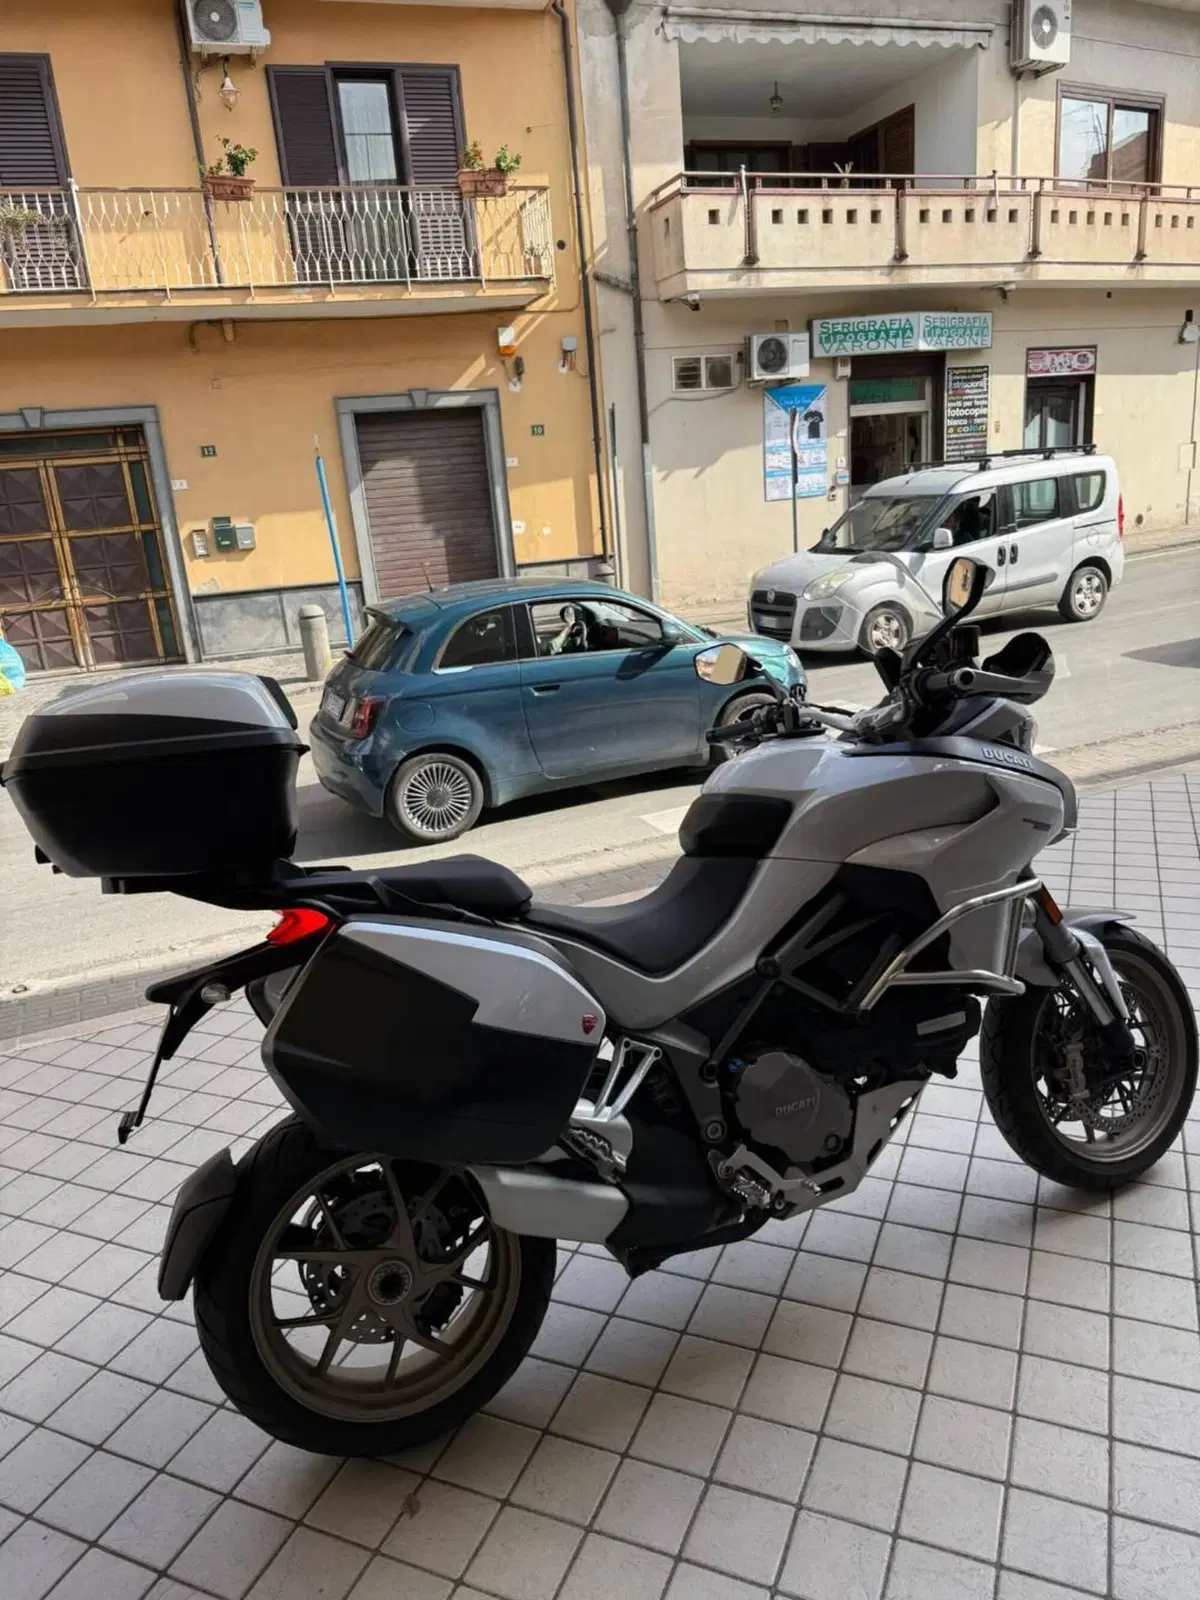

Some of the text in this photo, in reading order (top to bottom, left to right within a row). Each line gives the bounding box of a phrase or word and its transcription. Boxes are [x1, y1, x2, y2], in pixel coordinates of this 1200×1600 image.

[820, 329, 913, 344] TIPOGRAFIA
[924, 328, 988, 338] TIPOGRAFIA
[820, 339, 914, 354] VARONE
[924, 336, 988, 347] VARONE
[947, 406, 988, 417] fotocopie
[957, 424, 986, 433] colori
[203, 447, 213, 455] 12
[982, 748, 1034, 770] DUCATI
[775, 1096, 816, 1117] DUCATI
